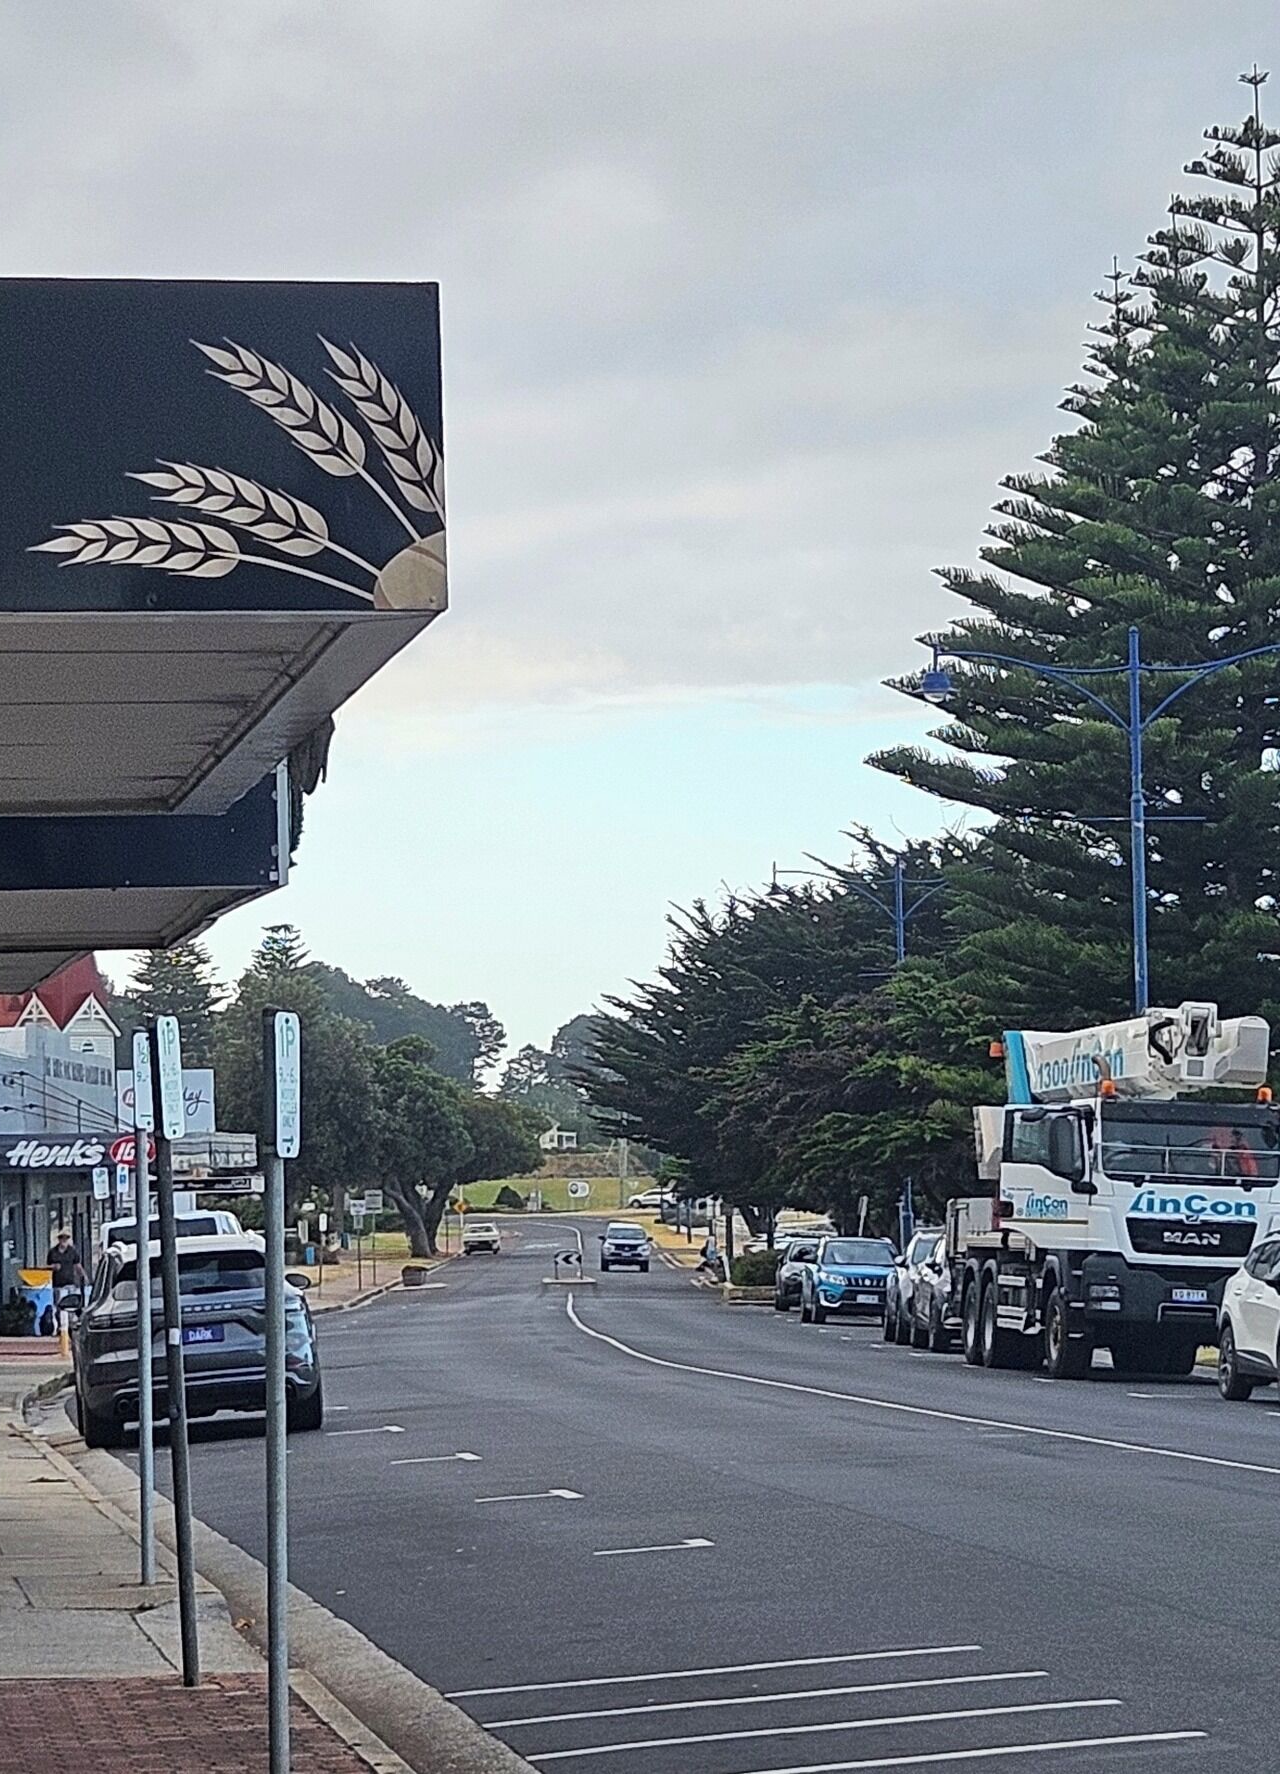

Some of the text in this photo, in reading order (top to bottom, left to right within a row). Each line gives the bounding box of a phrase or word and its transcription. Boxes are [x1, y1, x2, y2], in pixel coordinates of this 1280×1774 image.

[1038, 1057, 1070, 1091] 1300
[5, 1137, 150, 1168] Henk's IG
[1129, 1190, 1256, 1216] LinCon
[1163, 1231, 1220, 1245] MAN
